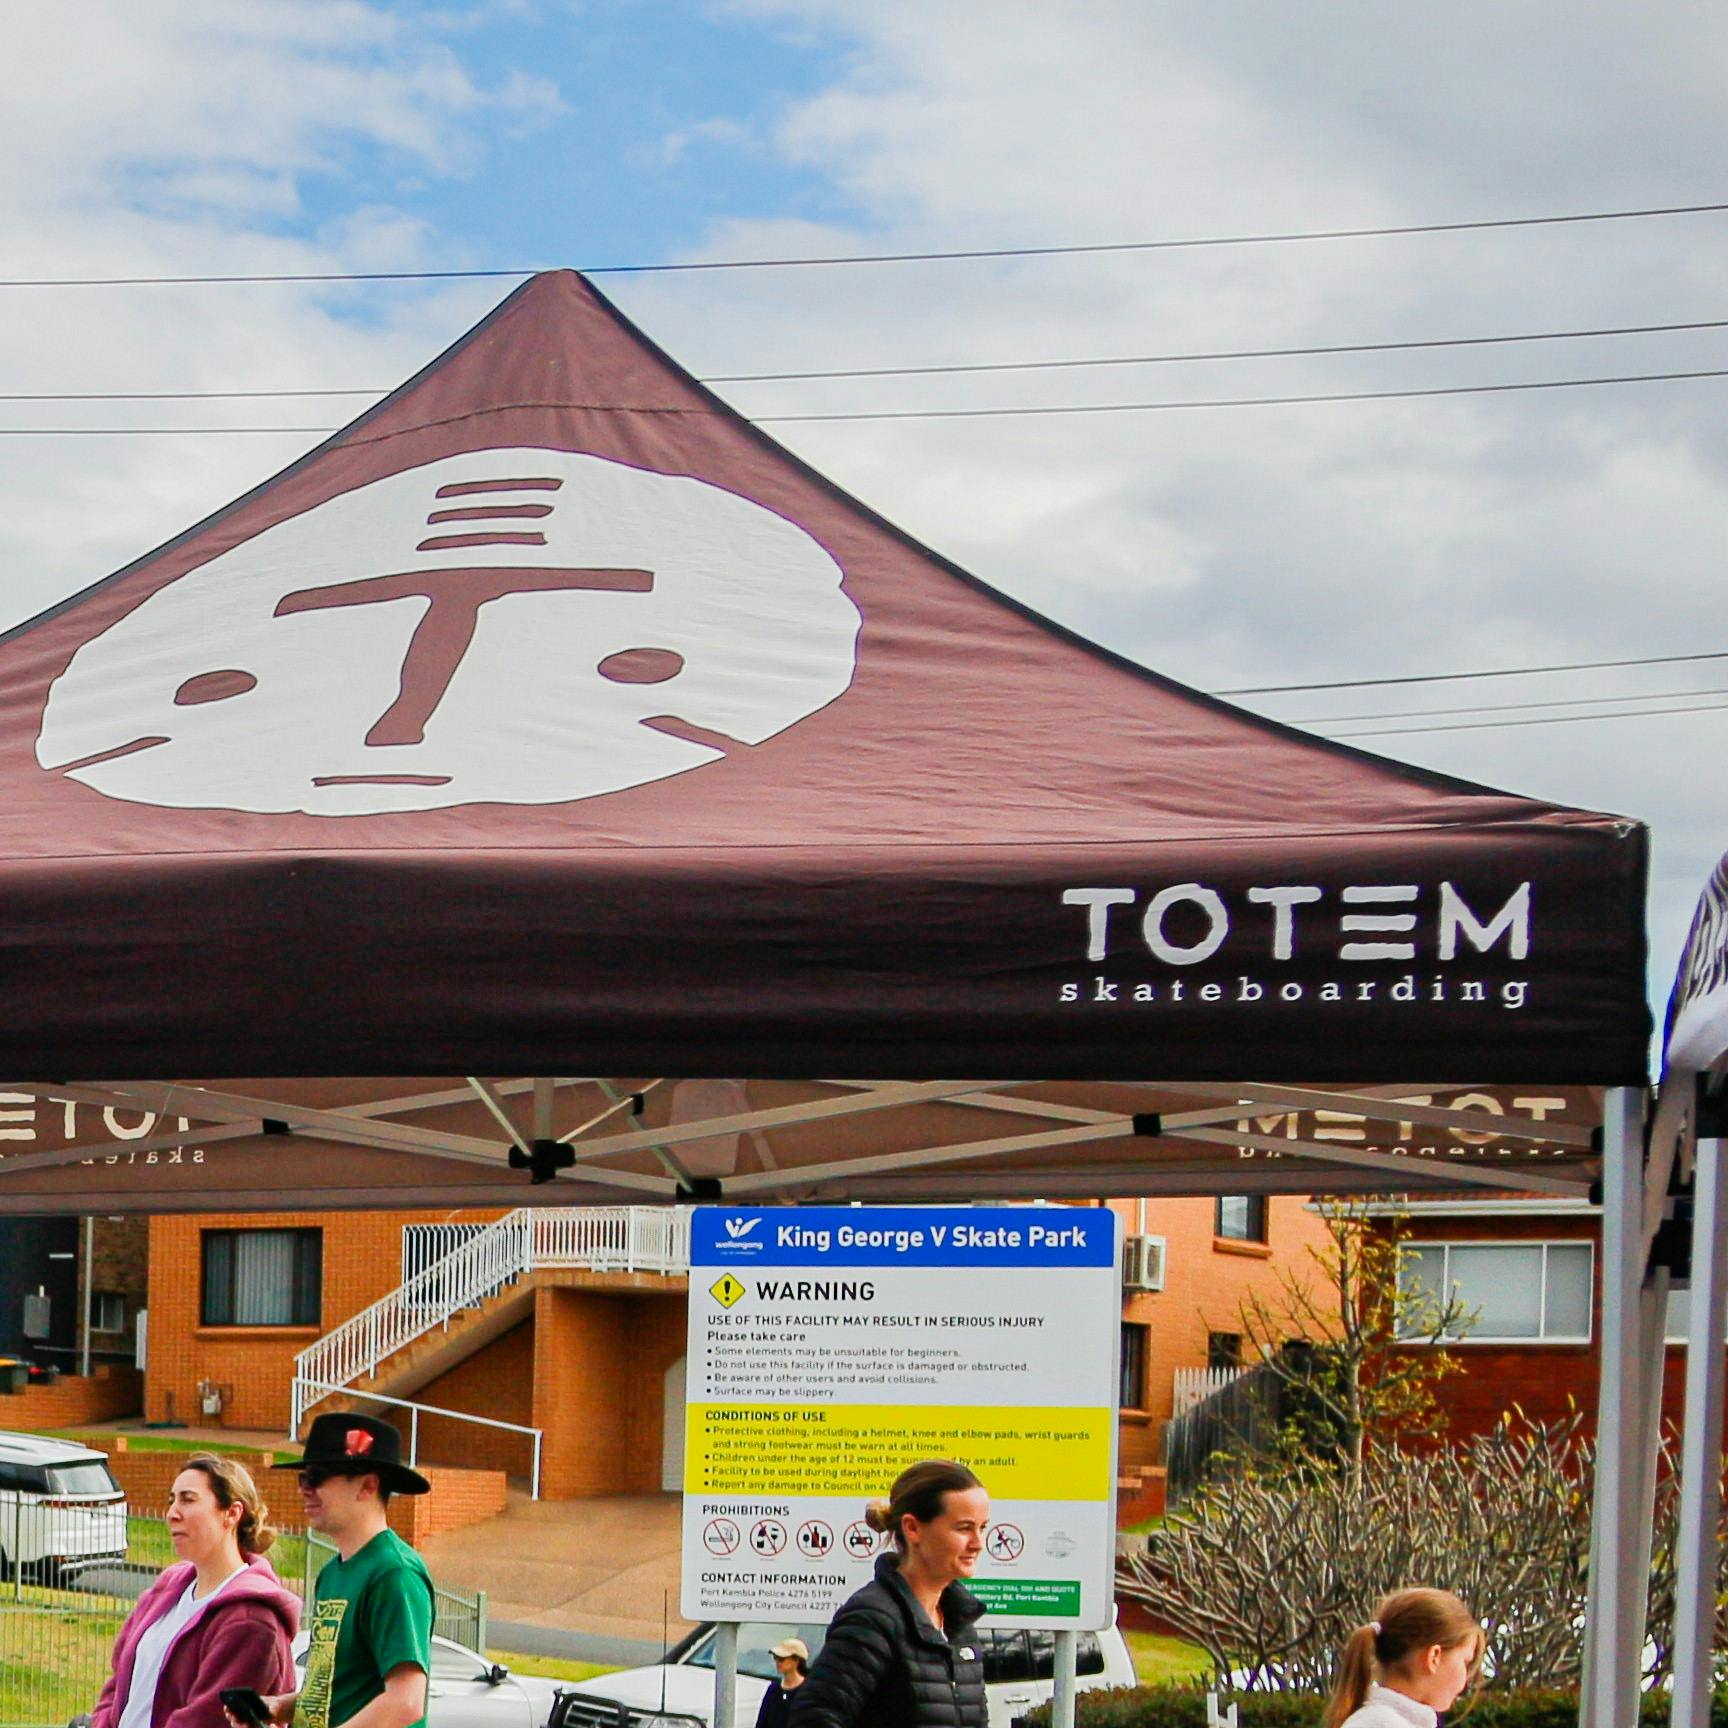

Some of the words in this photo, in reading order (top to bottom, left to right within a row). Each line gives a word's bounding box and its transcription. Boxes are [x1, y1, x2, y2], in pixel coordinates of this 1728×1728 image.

[1061, 880, 1532, 966] TOTEM
[1059, 975, 1531, 1009] skateboarding
[777, 1225, 831, 1252] King
[838, 1226, 924, 1252] George
[930, 1226, 947, 1248] V
[952, 1226, 1022, 1248] Skate
[1029, 1226, 1087, 1248] Park
[756, 1281, 875, 1301] WARNING
[708, 1315, 731, 1326] USE
[735, 1315, 751, 1326] OF
[755, 1315, 782, 1326] THIS
[786, 1315, 839, 1326] FACILITY
[843, 1315, 868, 1326] MAY
[873, 1316, 920, 1326] RESULT
[924, 1316, 938, 1326] IN
[941, 1316, 995, 1327] SERIOUS
[999, 1316, 1045, 1327] INJURY
[707, 1331, 747, 1341] Please
[750, 1332, 776, 1342] take
[780, 1334, 806, 1342] care
[715, 1347, 744, 1356] Some
[746, 1347, 792, 1356] elements
[795, 1350, 816, 1358] may
[819, 1348, 831, 1356] be
[834, 1348, 887, 1356] unsuitable
[890, 1348, 905, 1357] for
[715, 1361, 728, 1369] Do
[730, 1361, 746, 1369] not
[770, 1361, 788, 1369] this
[792, 1361, 824, 1372] facility
[827, 1361, 835, 1370] if
[837, 1361, 853, 1370] the
[856, 1362, 894, 1370] surface
[897, 1362, 905, 1370] is
[908, 1362, 955, 1372] damaged
[715, 1374, 727, 1382] Be
[764, 1374, 773, 1382] of
[776, 1374, 802, 1383] other
[837, 1375, 855, 1383] and
[858, 1375, 885, 1383] avoid
[714, 1387, 752, 1395] Surface
[755, 1389, 776, 1397] may
[779, 1388, 791, 1396] be
[705, 1411, 780, 1421] CONDITIONS
[784, 1412, 799, 1422] OF
[803, 1412, 826, 1422] USE
[713, 1426, 764, 1435] Protective
[812, 1427, 859, 1438] including
[912, 1429, 937, 1437] knee
[940, 1429, 958, 1437] and
[961, 1429, 992, 1438] elbow
[1025, 1430, 1051, 1438] wrist
[1054, 1430, 1090, 1441] guards
[713, 1440, 731, 1448] and
[734, 1440, 766, 1450] strong
[769, 1441, 812, 1449] footwear
[816, 1441, 841, 1449] must
[844, 1442, 857, 1450] be
[888, 1442, 898, 1450] at
[900, 1442, 914, 1450] all
[712, 1454, 755, 1462] Children
[758, 1454, 786, 1463] under
[789, 1455, 805, 1463] the
[809, 1457, 828, 1465] age
[830, 1455, 840, 1463] of
[843, 1455, 854, 1464] 12
[857, 1456, 883, 1464] must
[886, 1456, 898, 1464] be
[712, 1468, 748, 1478] Facility
[751, 1468, 761, 1476] to
[764, 1468, 775, 1476] be
[778, 1468, 802, 1476] used
[805, 1469, 838, 1479] during
[840, 1469, 885, 1479] daylight
[712, 1480, 745, 1490] Report
[748, 1483, 766, 1491] any
[768, 1481, 808, 1491] damage
[811, 1481, 821, 1489] to
[702, 1505, 790, 1516] PROHIBITIONS
[701, 1573, 755, 1583] CONTACT
[760, 1574, 846, 1584] INFORMATION
